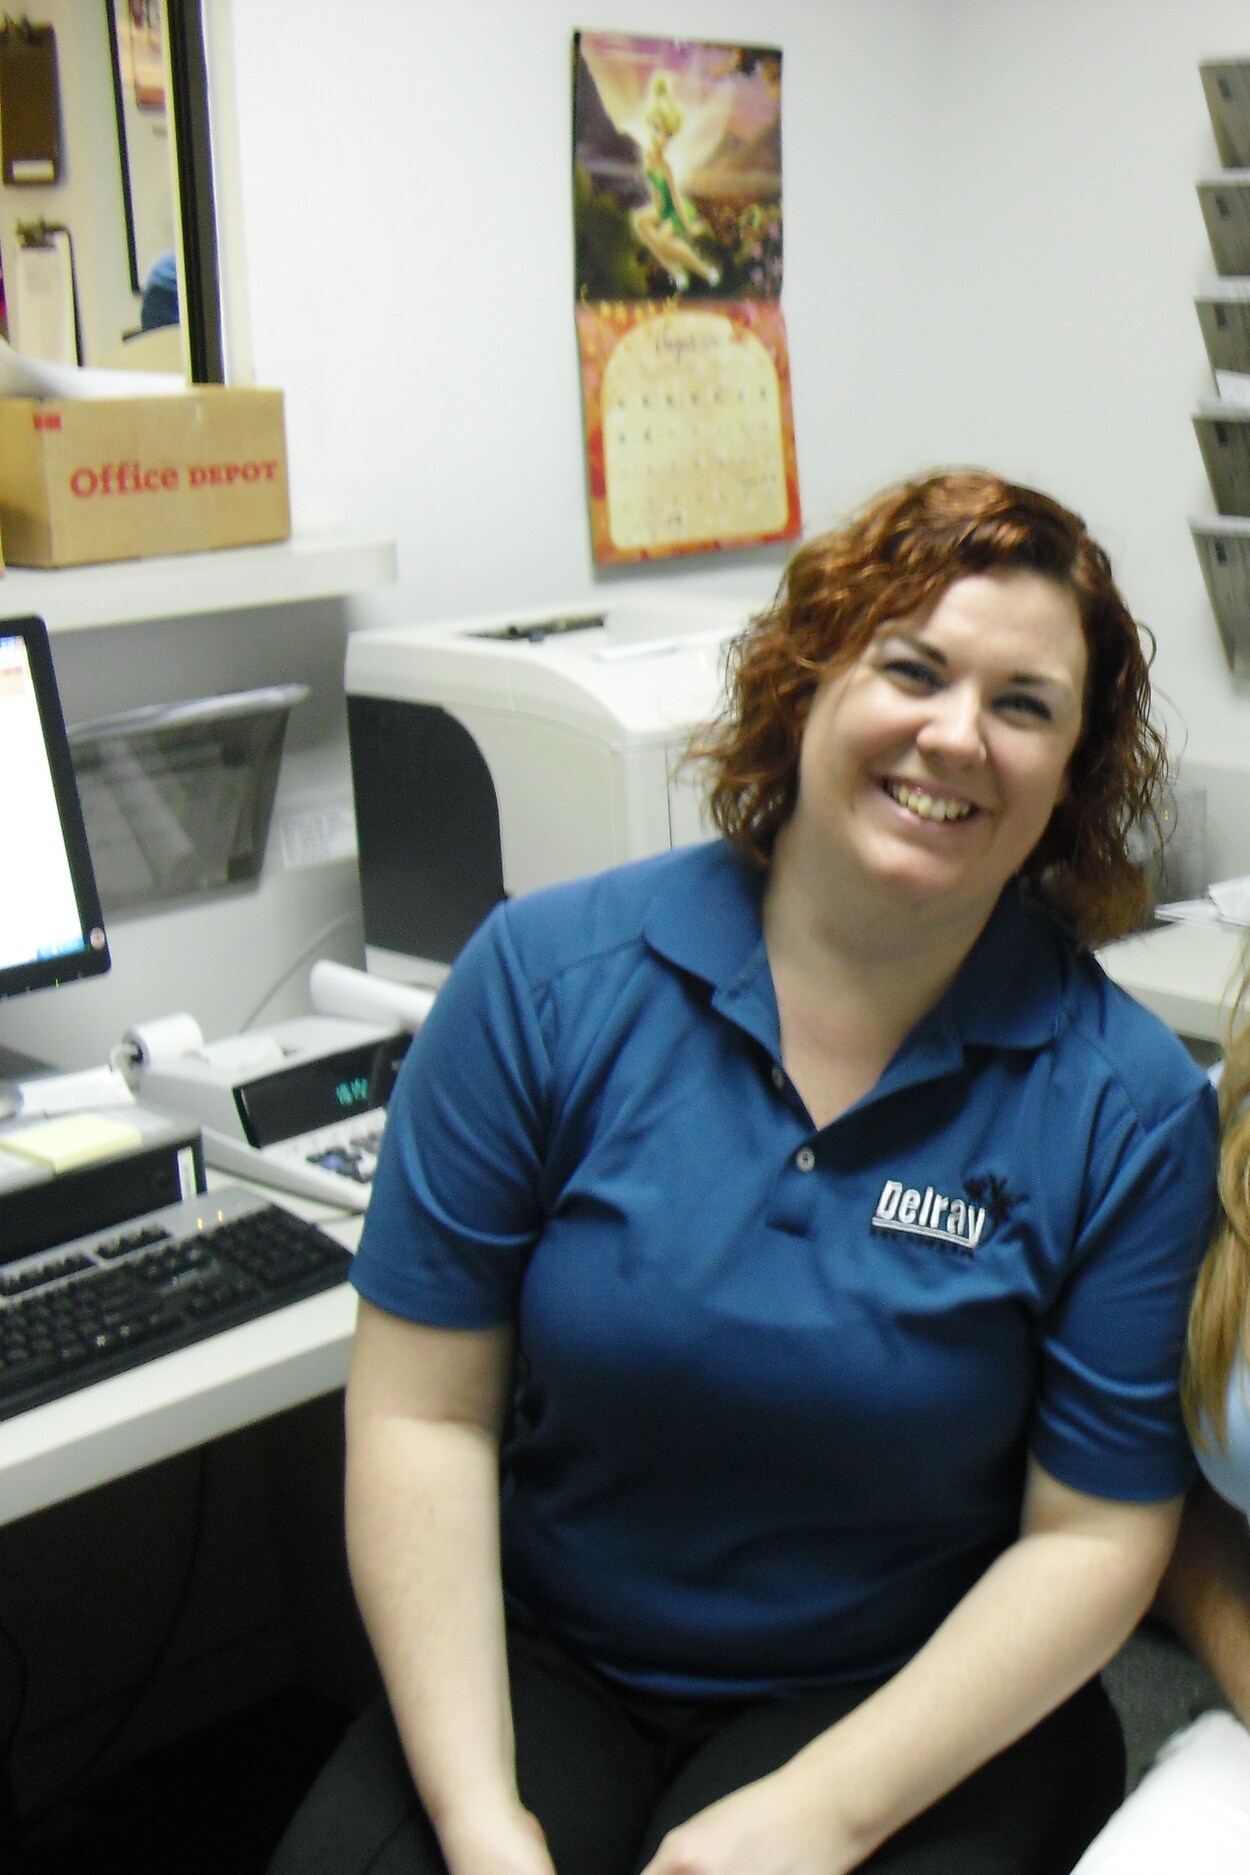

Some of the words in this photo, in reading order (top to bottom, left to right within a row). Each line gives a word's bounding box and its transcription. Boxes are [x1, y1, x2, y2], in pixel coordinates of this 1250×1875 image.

[69, 460, 179, 498] Office
[187, 459, 278, 489] DEPOT
[875, 1179, 986, 1249] Delray
